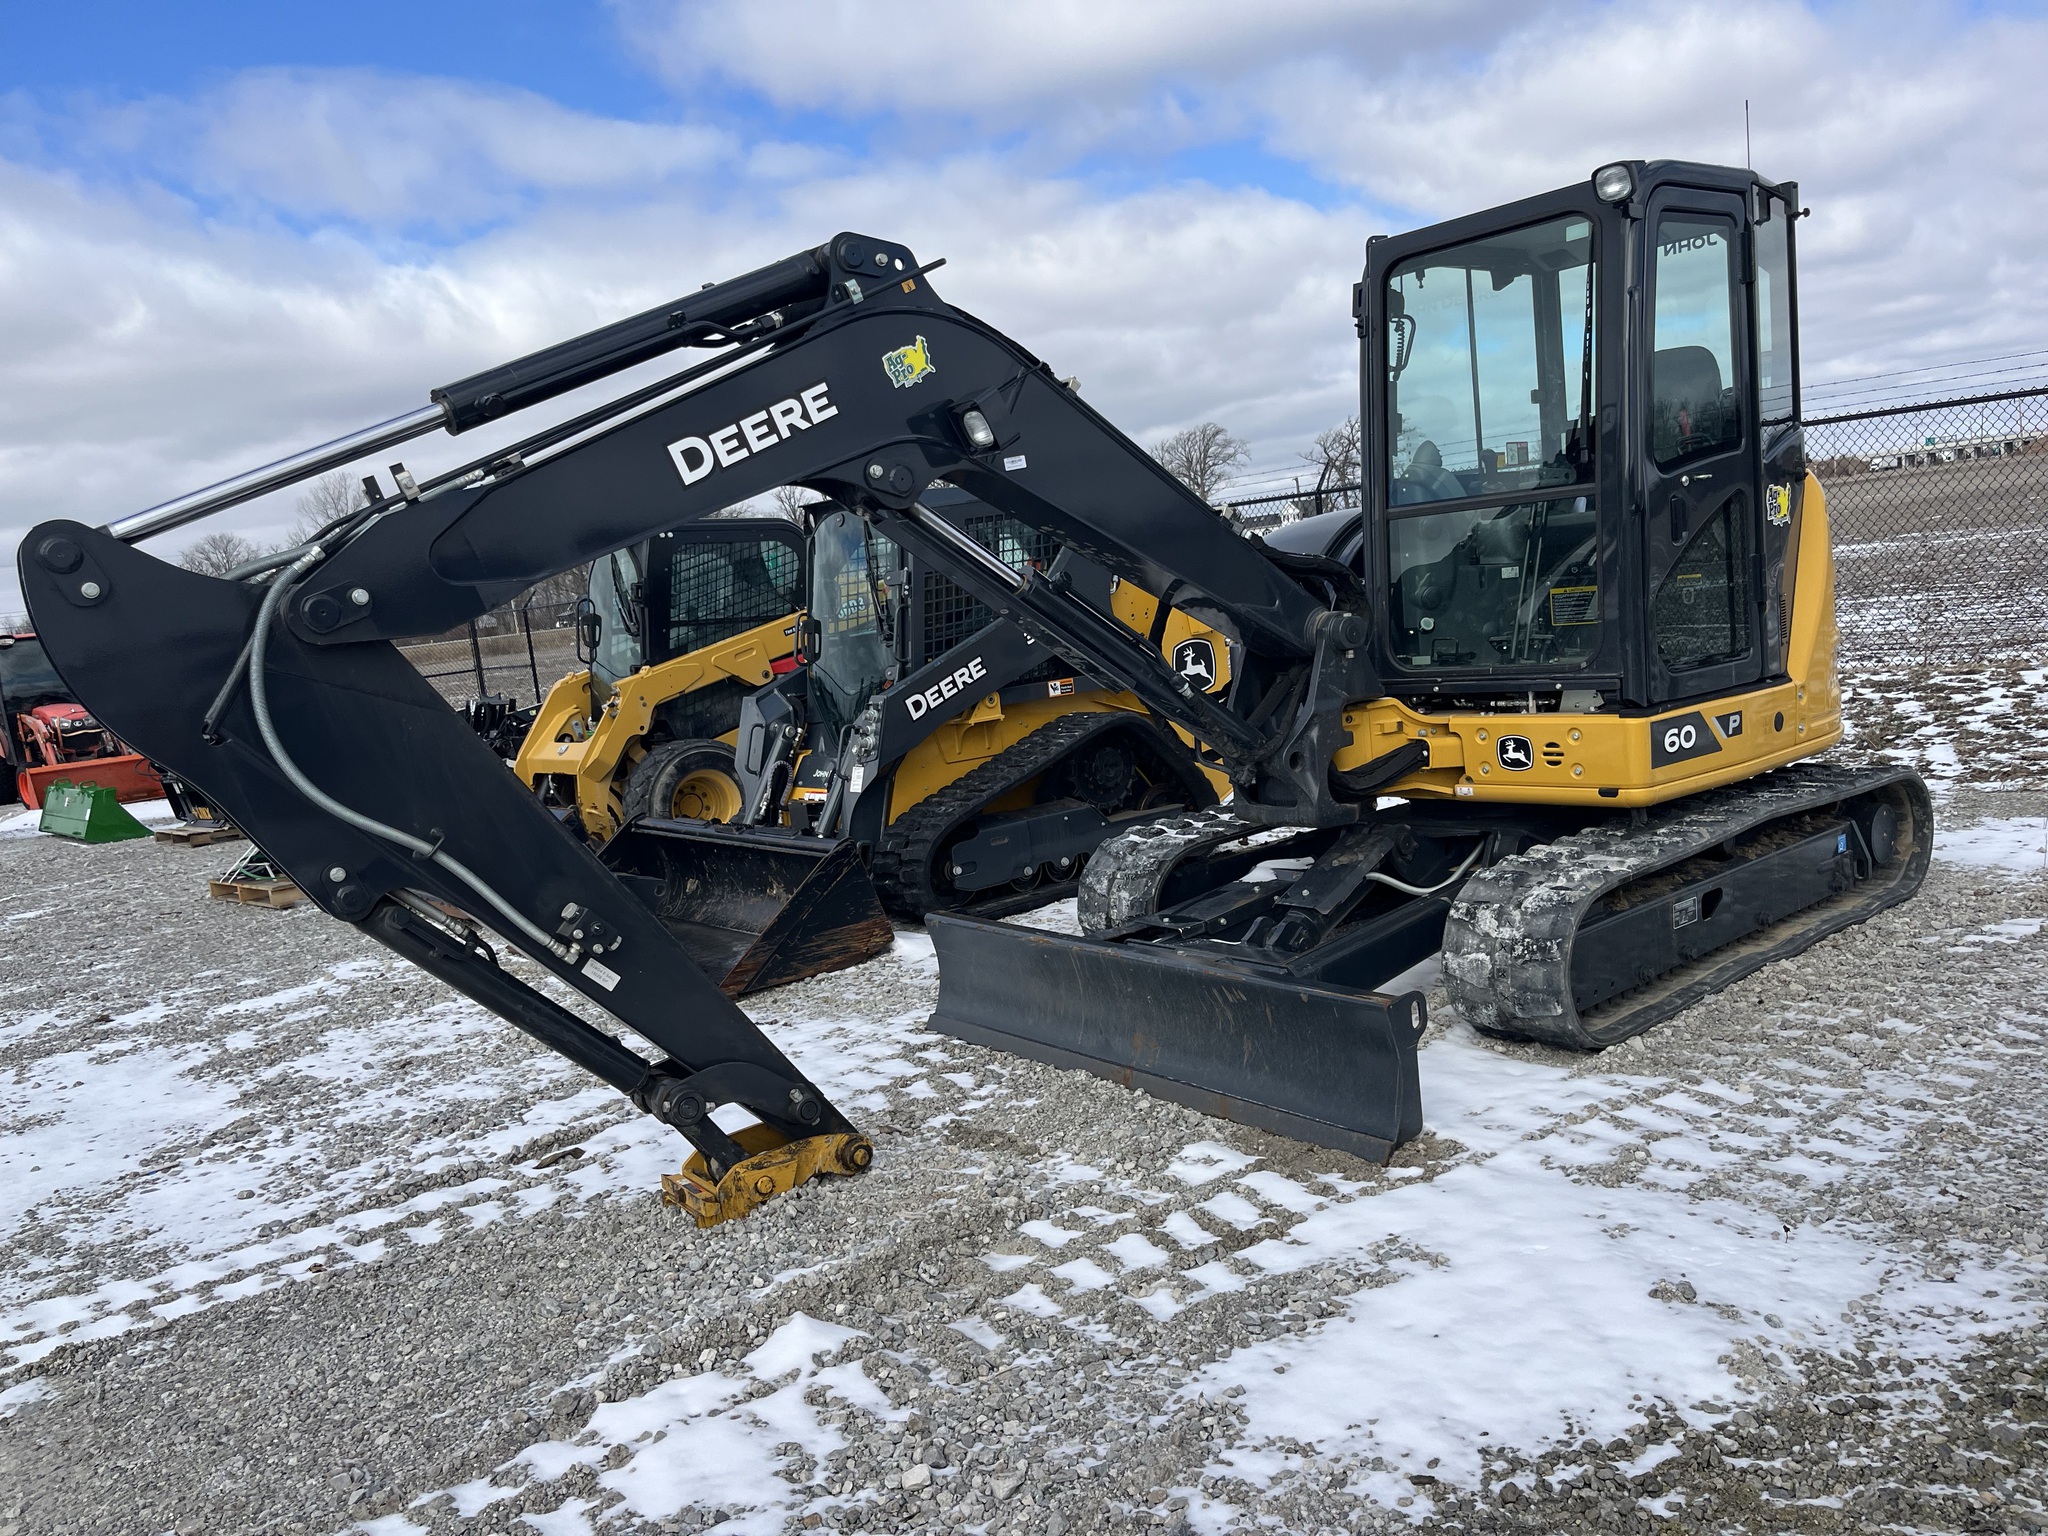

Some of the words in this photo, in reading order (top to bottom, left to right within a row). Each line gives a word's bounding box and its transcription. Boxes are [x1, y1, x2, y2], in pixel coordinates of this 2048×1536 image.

[891, 363, 915, 385] Pro
[667, 382, 838, 486] DEERE
[905, 656, 987, 721] DEERE
[1664, 724, 1697, 754] 60
[1728, 714, 1740, 735] P
